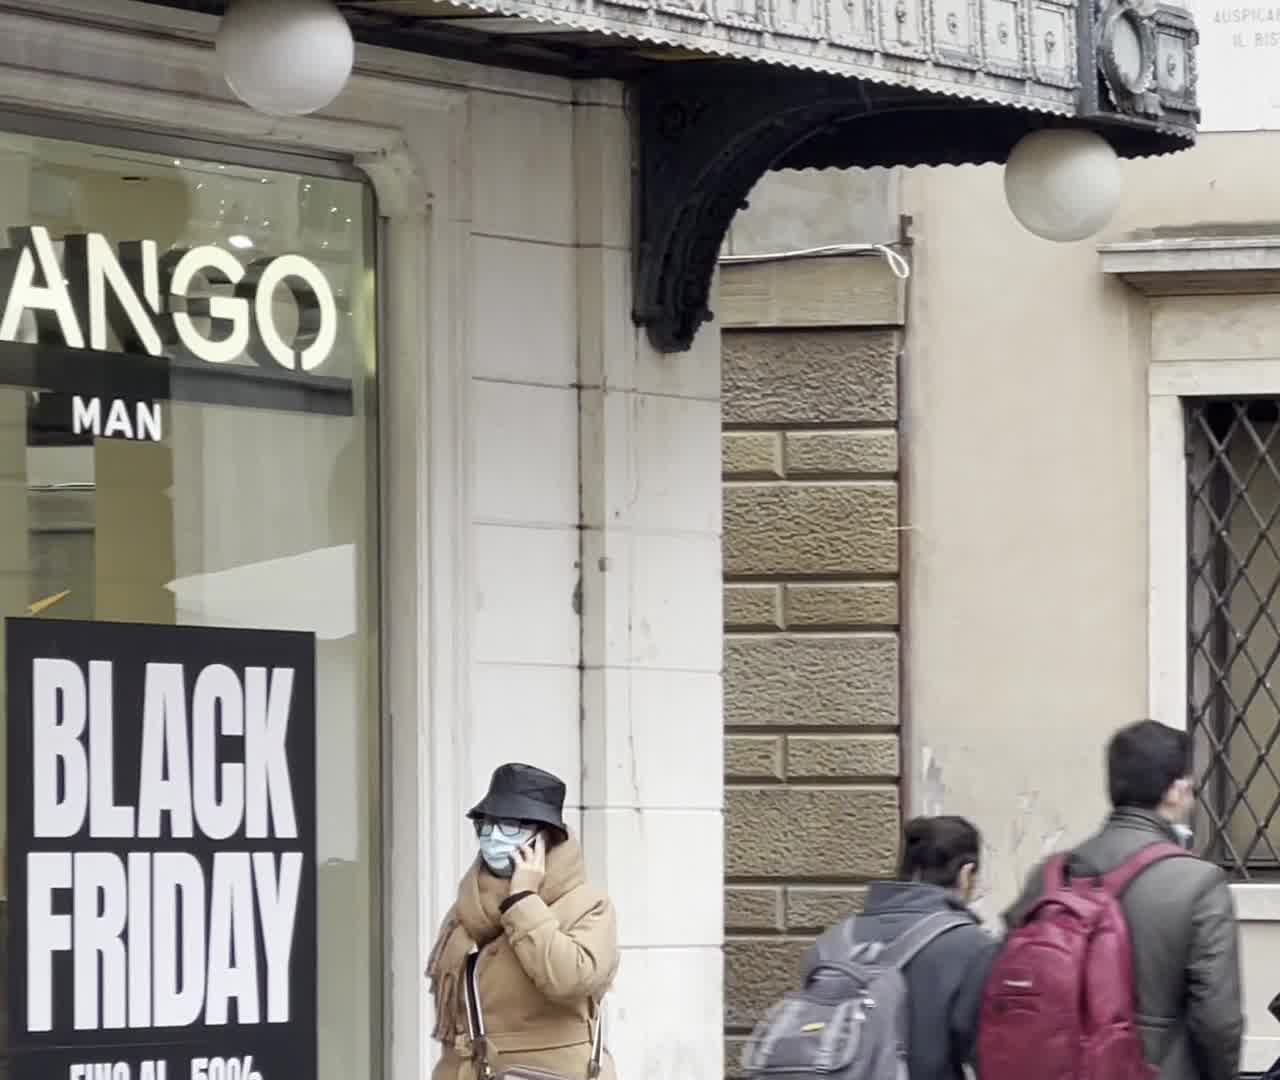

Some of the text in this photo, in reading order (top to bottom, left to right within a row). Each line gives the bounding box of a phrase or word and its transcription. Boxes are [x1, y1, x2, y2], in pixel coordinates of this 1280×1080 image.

[71, 395, 163, 442] MAN
[32, 657, 299, 840] BLACK
[26, 851, 304, 1033] FRIDAY
